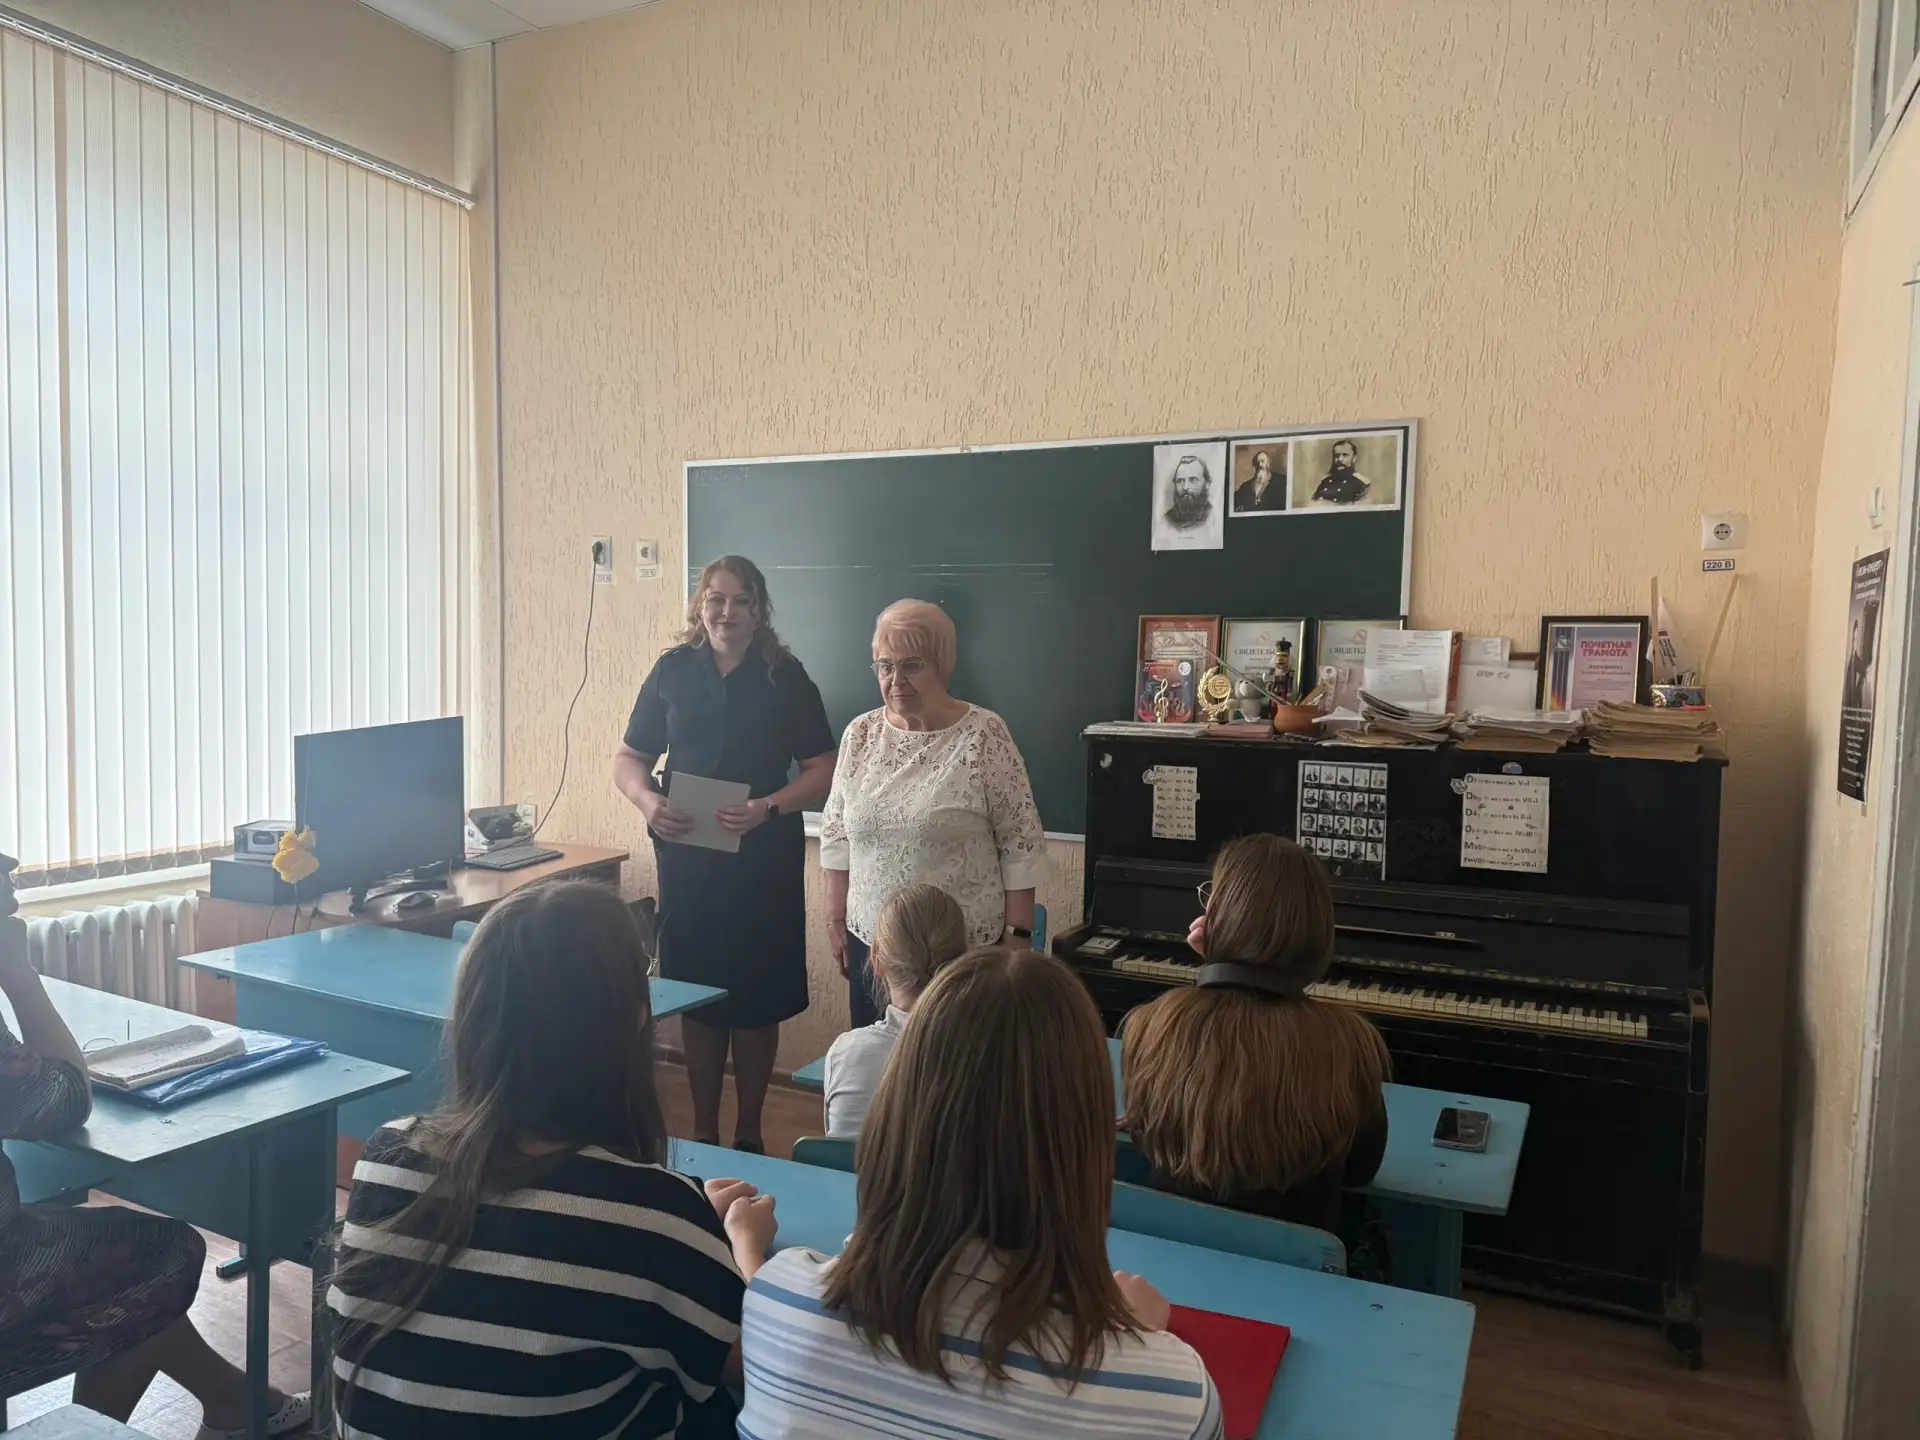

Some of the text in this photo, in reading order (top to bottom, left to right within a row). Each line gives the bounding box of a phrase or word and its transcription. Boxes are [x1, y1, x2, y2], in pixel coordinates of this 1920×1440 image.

[1706, 560, 1731, 569] 220 В
[1580, 640, 1633, 649] ПОЧЕТНАЯ
[1583, 648, 1629, 657] ГРАМОТА
